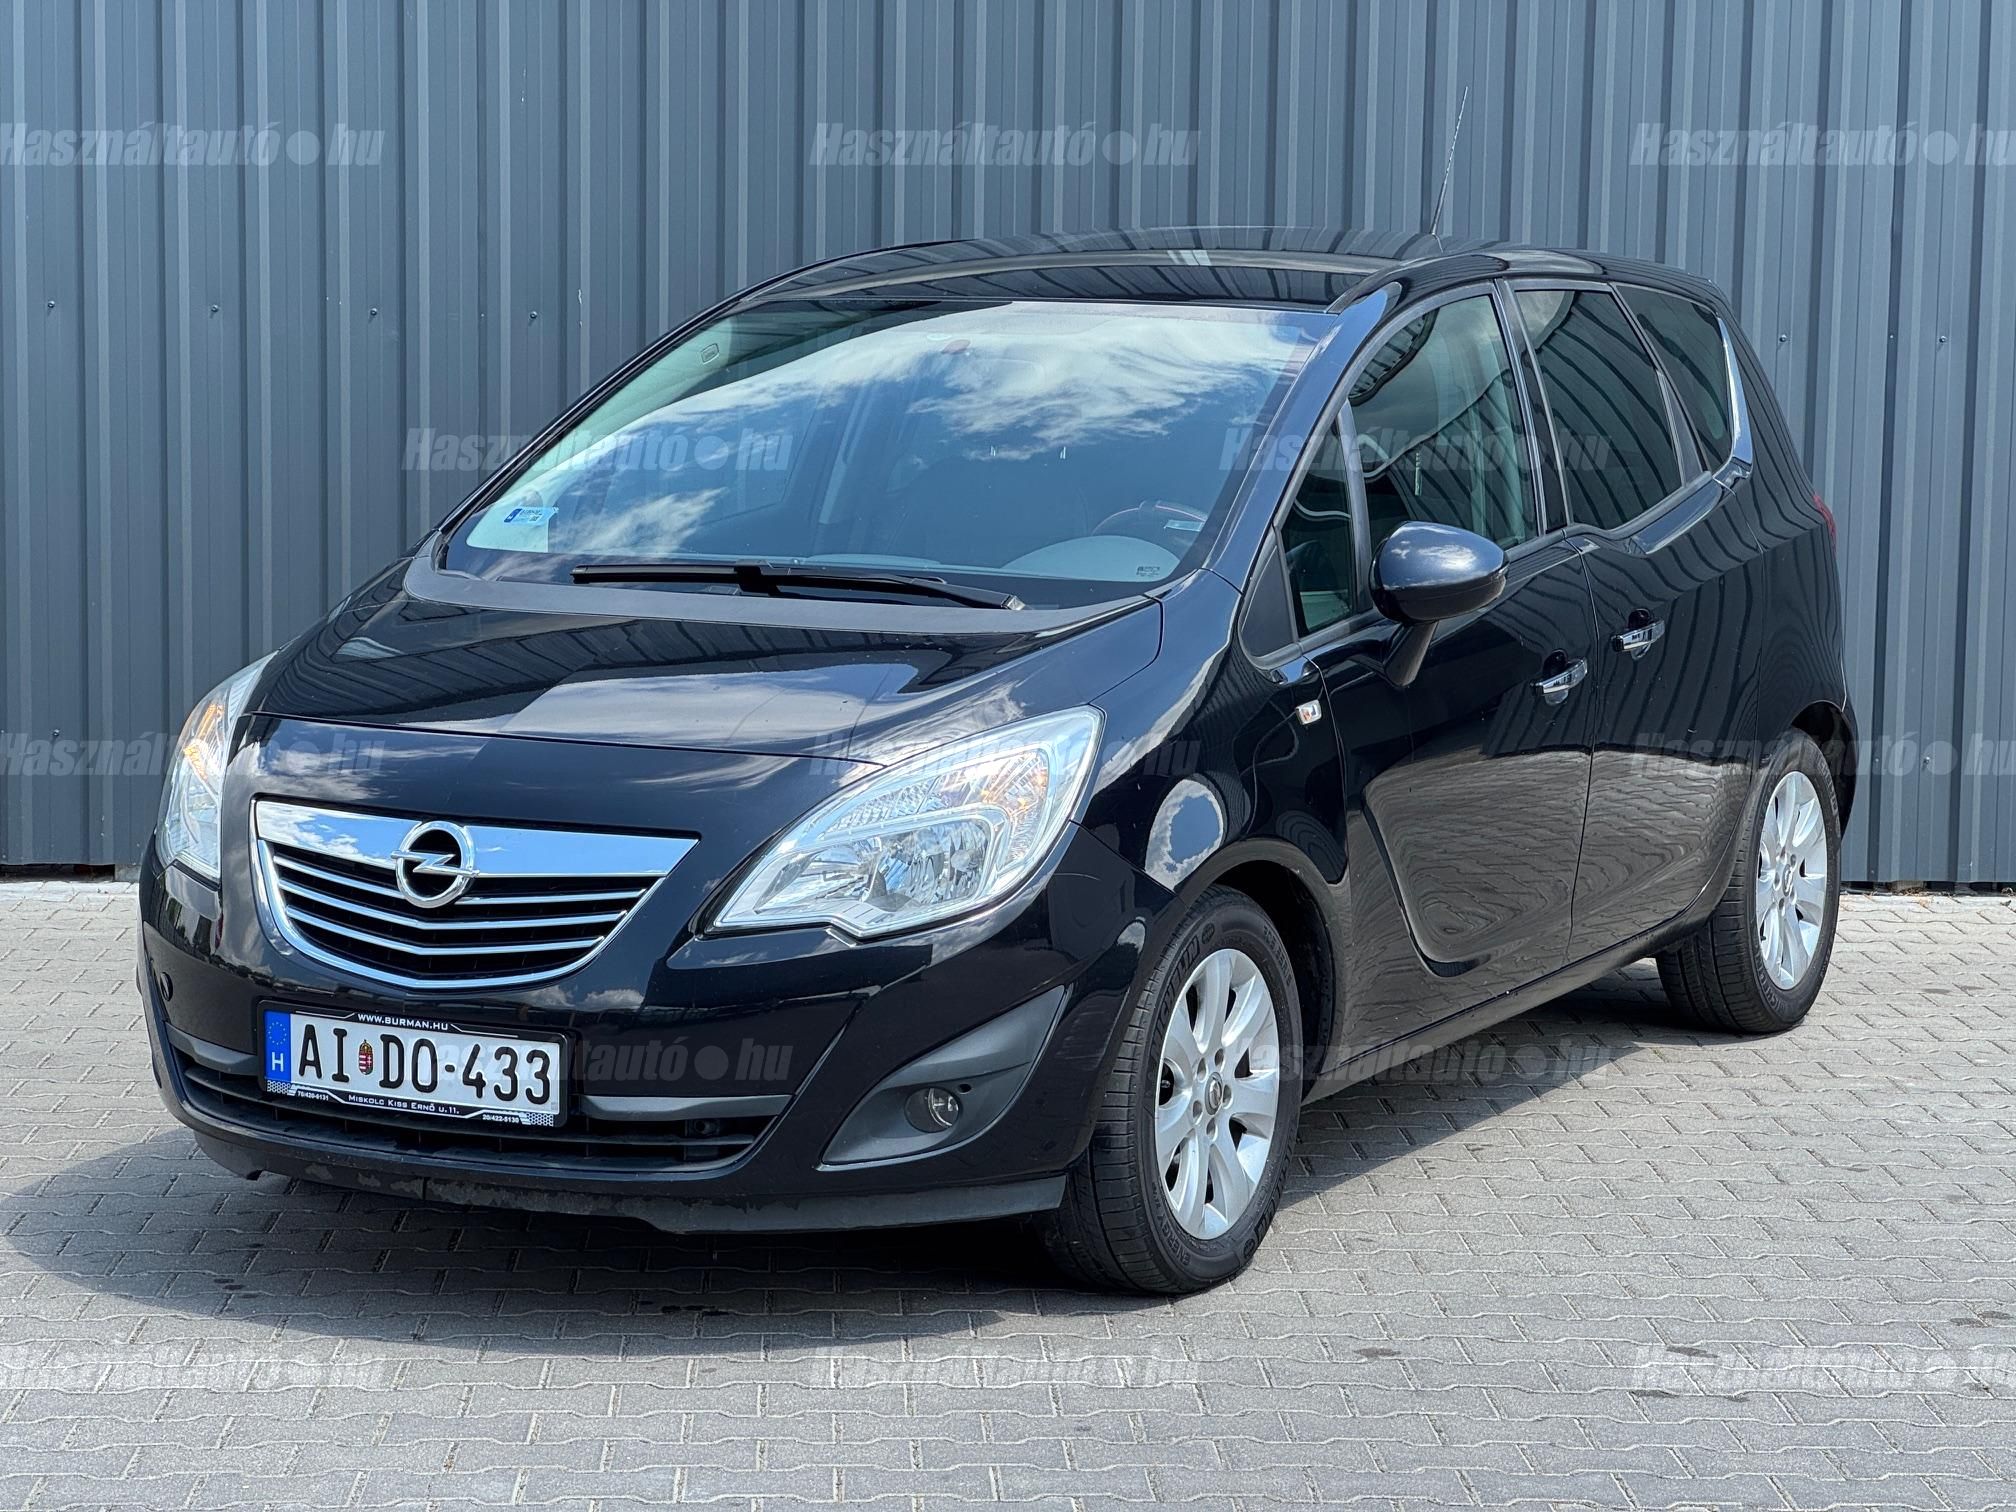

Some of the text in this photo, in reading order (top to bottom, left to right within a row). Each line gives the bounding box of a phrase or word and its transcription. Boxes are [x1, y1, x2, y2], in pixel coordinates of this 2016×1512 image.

[357, 1013, 448, 1031] WWW.BURMAN.HU
[271, 1051, 284, 1072] H
[299, 1024, 550, 1105] AI DO-433
